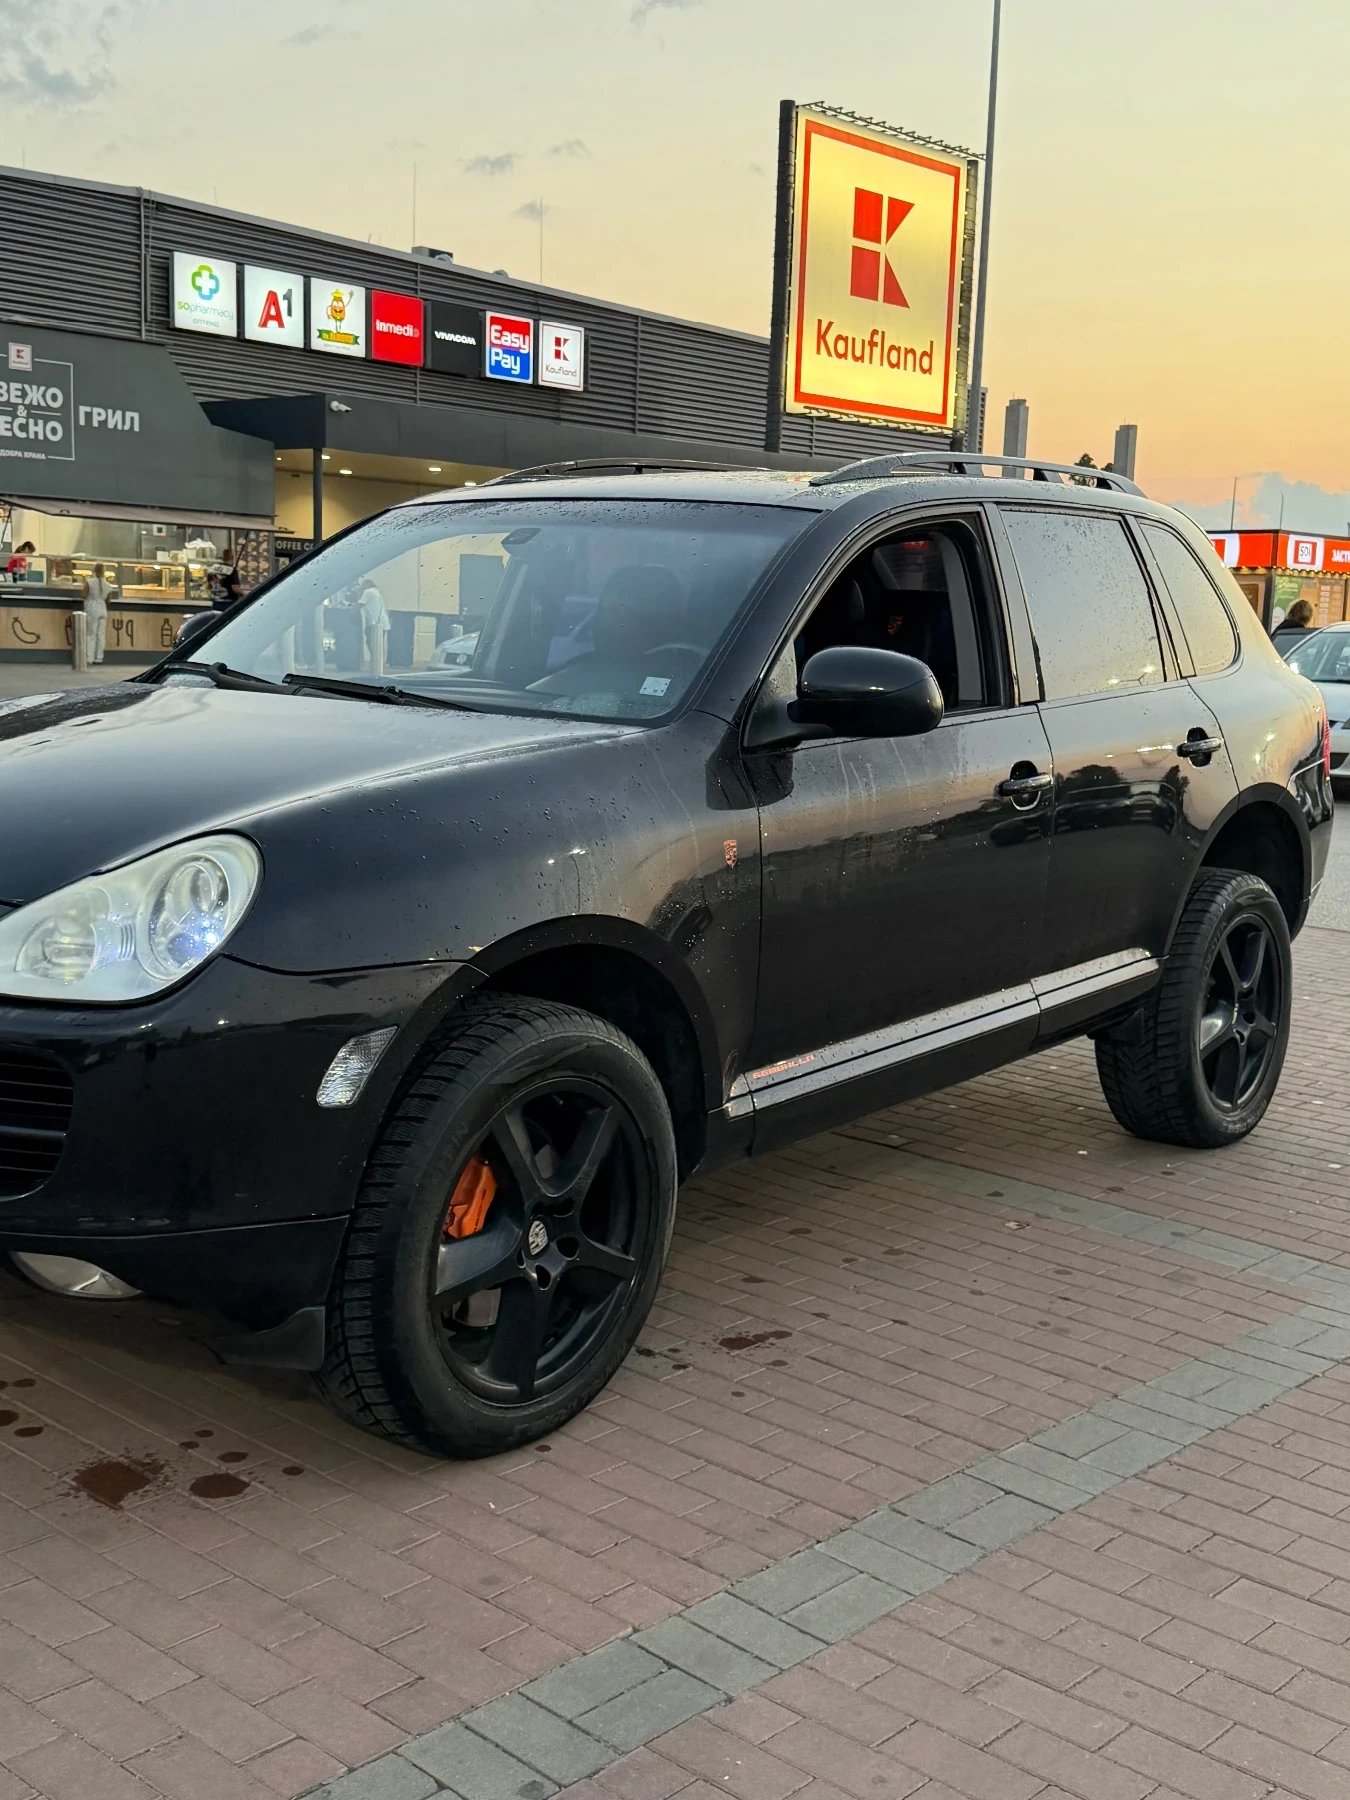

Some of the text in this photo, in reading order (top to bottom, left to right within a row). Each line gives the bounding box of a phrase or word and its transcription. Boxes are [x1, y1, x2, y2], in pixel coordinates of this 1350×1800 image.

[177, 301, 234, 321] sopharmacy
[258, 289, 293, 329] A1
[192, 318, 219, 328] аптека
[375, 319, 419, 338] inmedio
[490, 324, 530, 354] Easy
[816, 318, 934, 376] Kaufland
[490, 350, 521, 375] Pay
[545, 364, 578, 378] Kaufland
[16, 404, 28, 418] &
[78, 405, 140, 432] ГРИЛ
